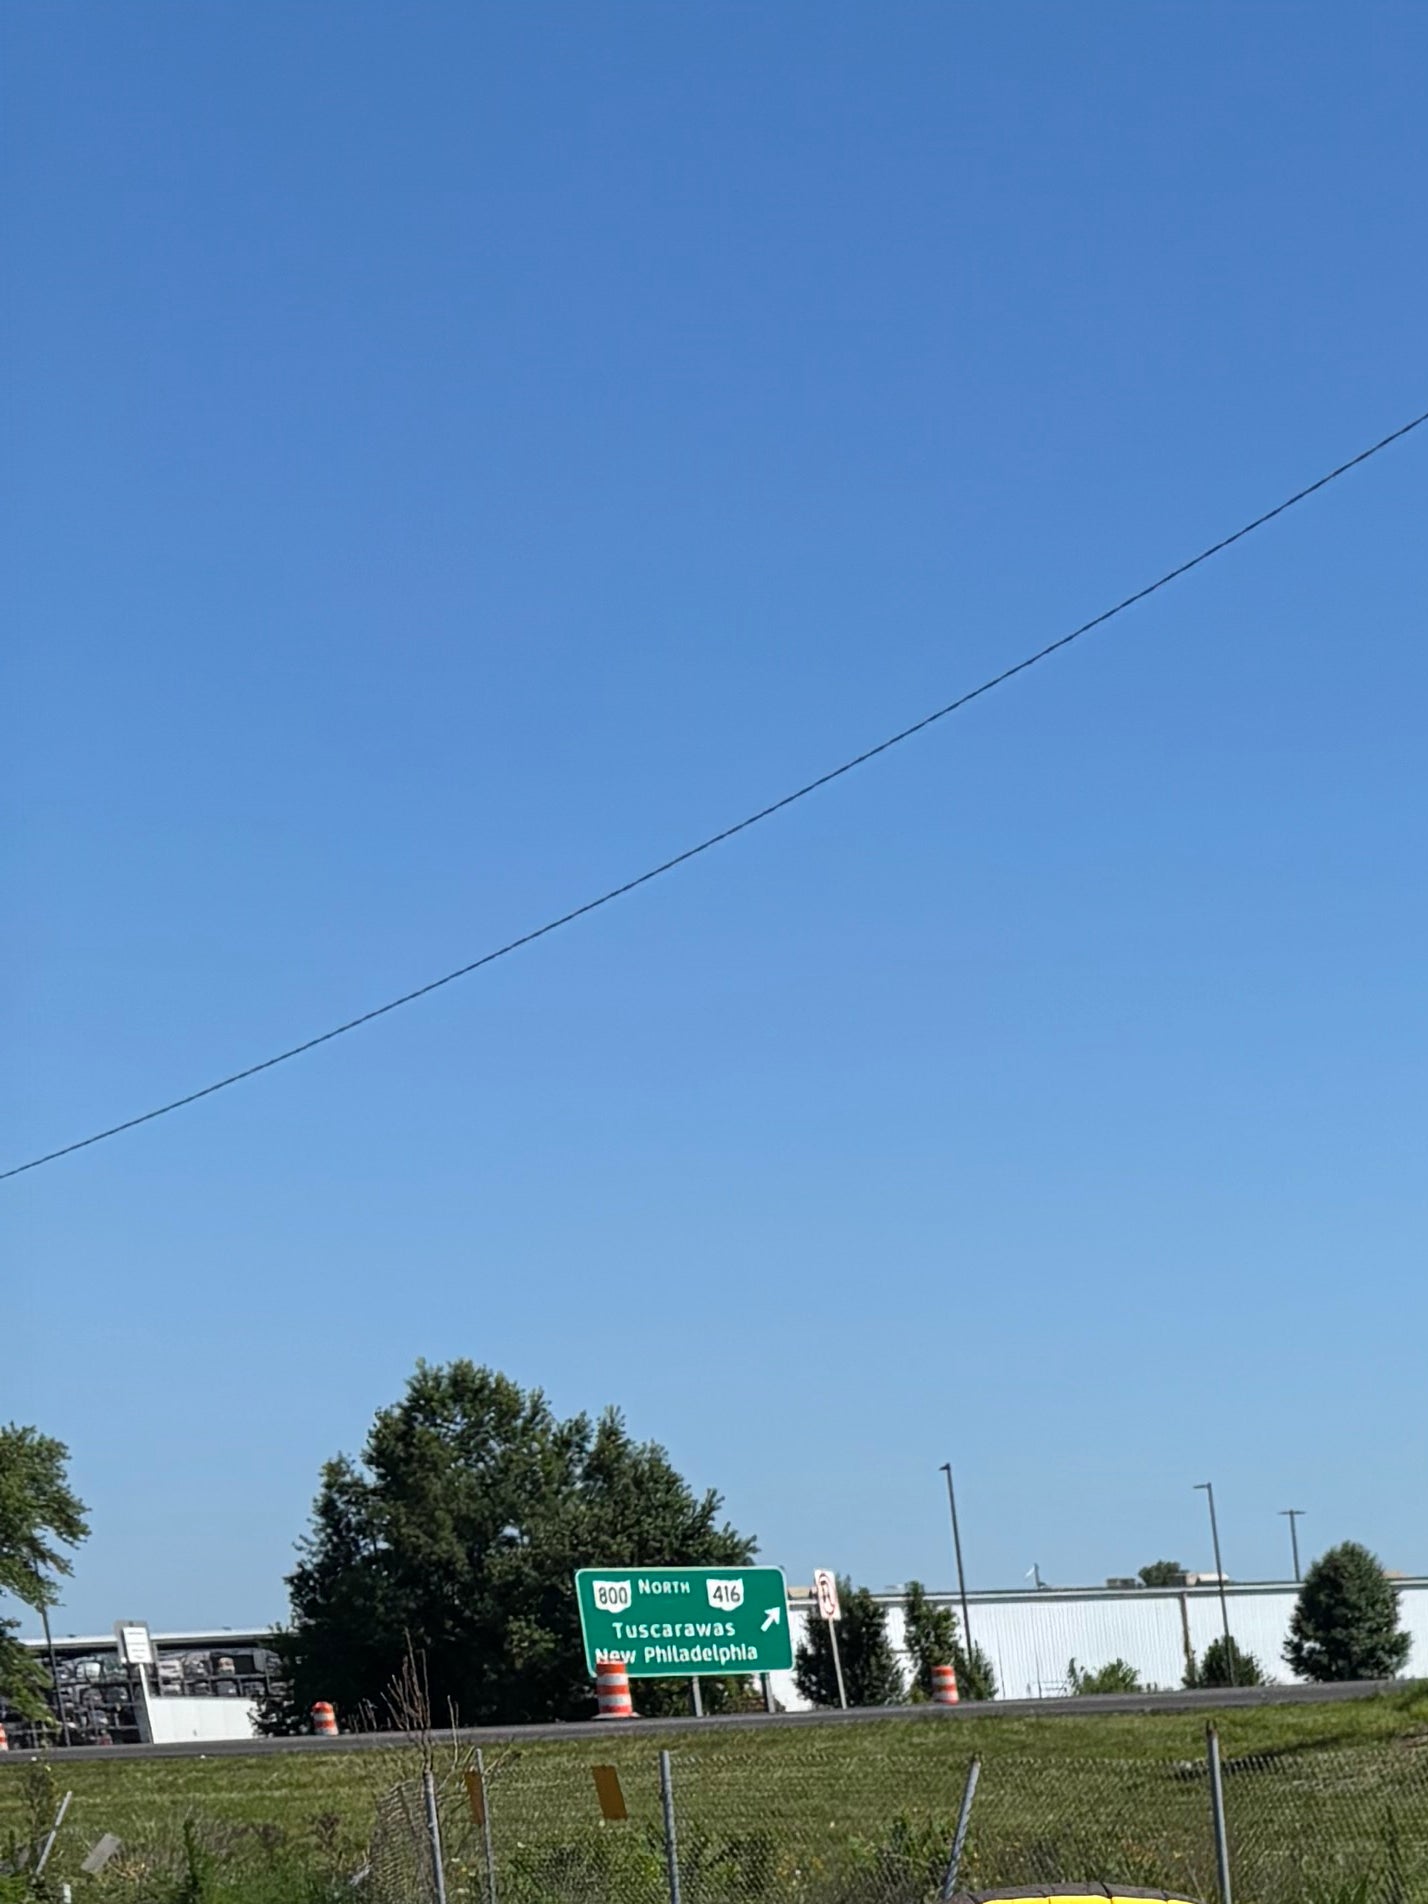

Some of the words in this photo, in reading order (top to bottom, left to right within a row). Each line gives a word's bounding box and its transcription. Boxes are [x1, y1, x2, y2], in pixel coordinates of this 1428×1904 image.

[598, 1586, 628, 1605] 800
[638, 1578, 691, 1595] NORTH
[712, 1584, 741, 1603] 416
[611, 1621, 736, 1639] Tuscarawas
[595, 1647, 636, 1665] New
[644, 1643, 759, 1666] Philadelphia
